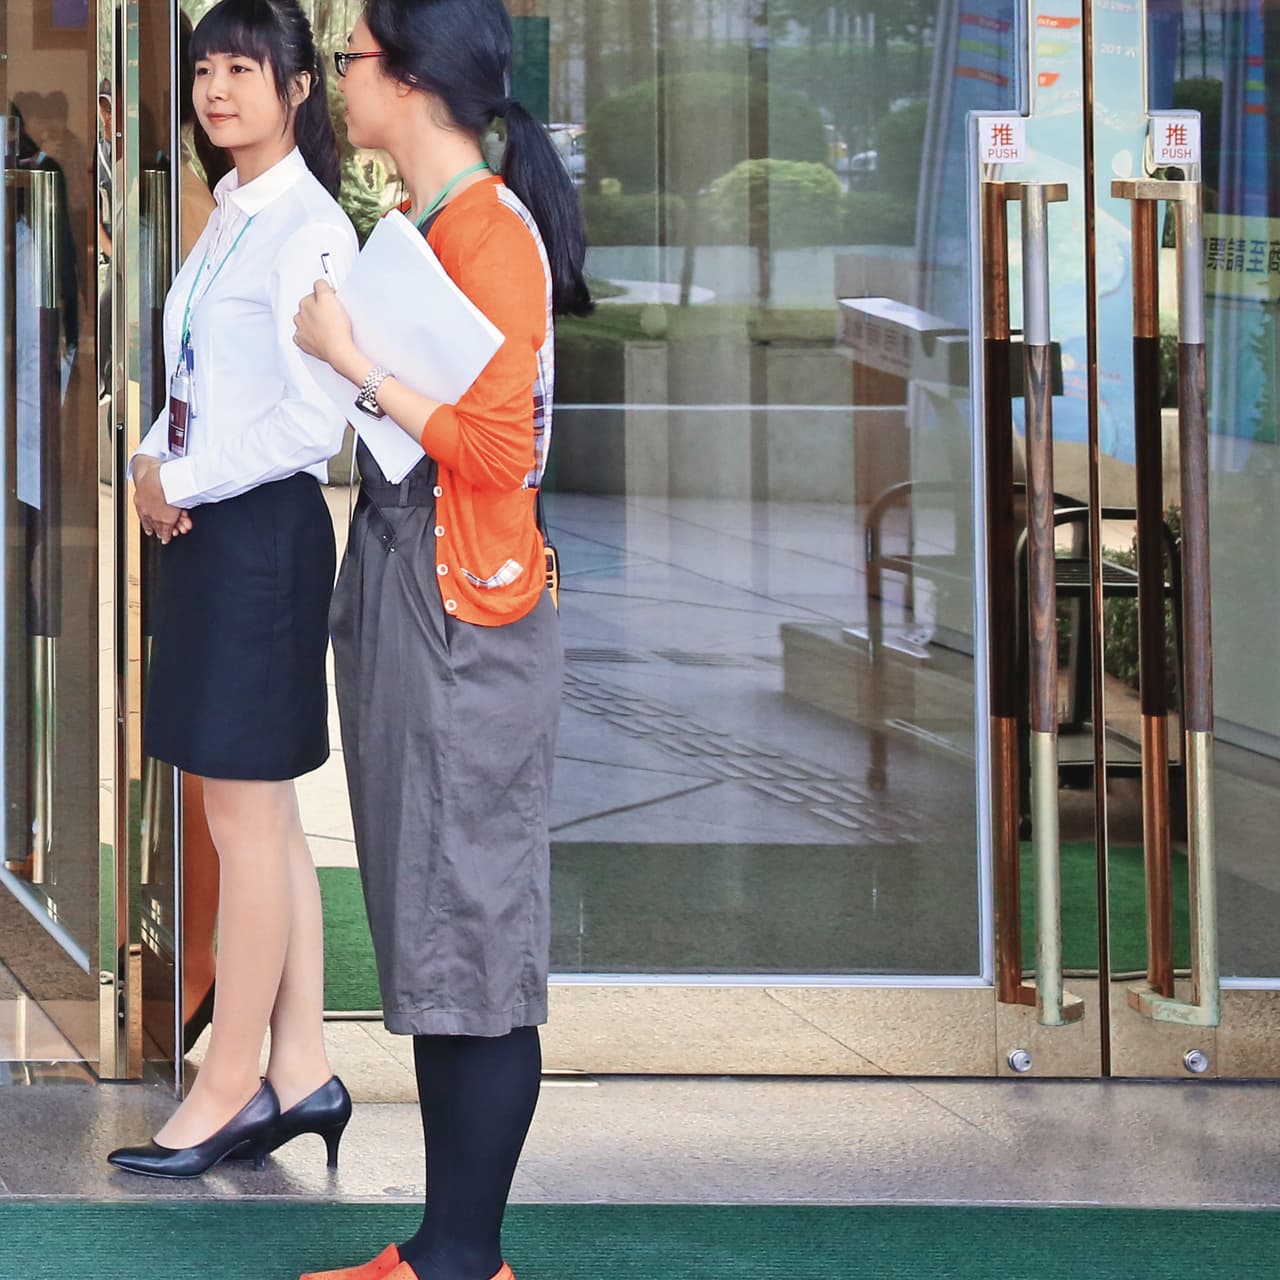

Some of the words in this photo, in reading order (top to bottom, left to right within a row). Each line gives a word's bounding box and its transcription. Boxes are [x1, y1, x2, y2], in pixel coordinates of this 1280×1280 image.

[991, 123, 1014, 146] 推
[1165, 123, 1188, 146] 推
[988, 149, 1018, 159] PUSH
[1162, 149, 1192, 159] PUSH
